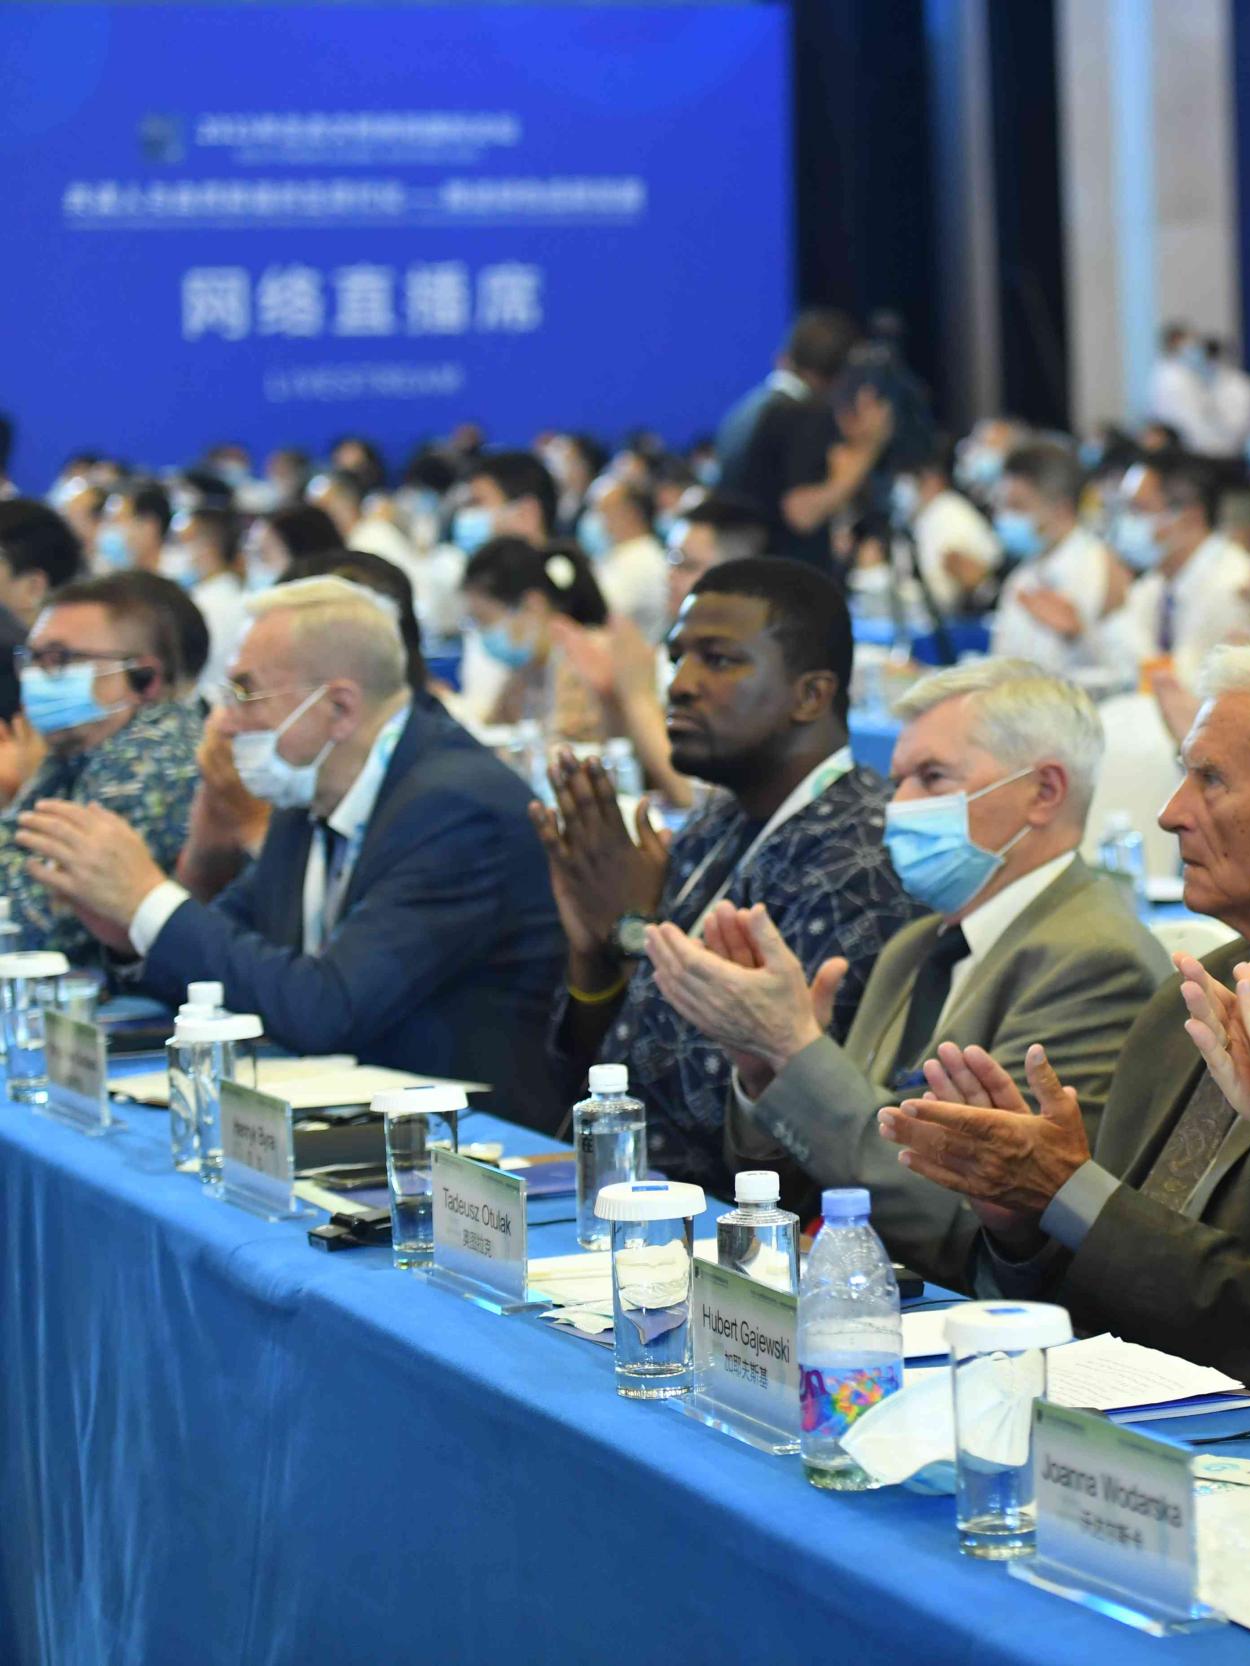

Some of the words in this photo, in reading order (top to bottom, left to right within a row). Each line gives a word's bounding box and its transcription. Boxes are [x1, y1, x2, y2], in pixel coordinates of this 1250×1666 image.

[442, 1187, 479, 1222] Tadeusz
[481, 1204, 511, 1236] Otulak
[702, 1303, 738, 1341] Hubert
[740, 1320, 790, 1363] Gajewski
